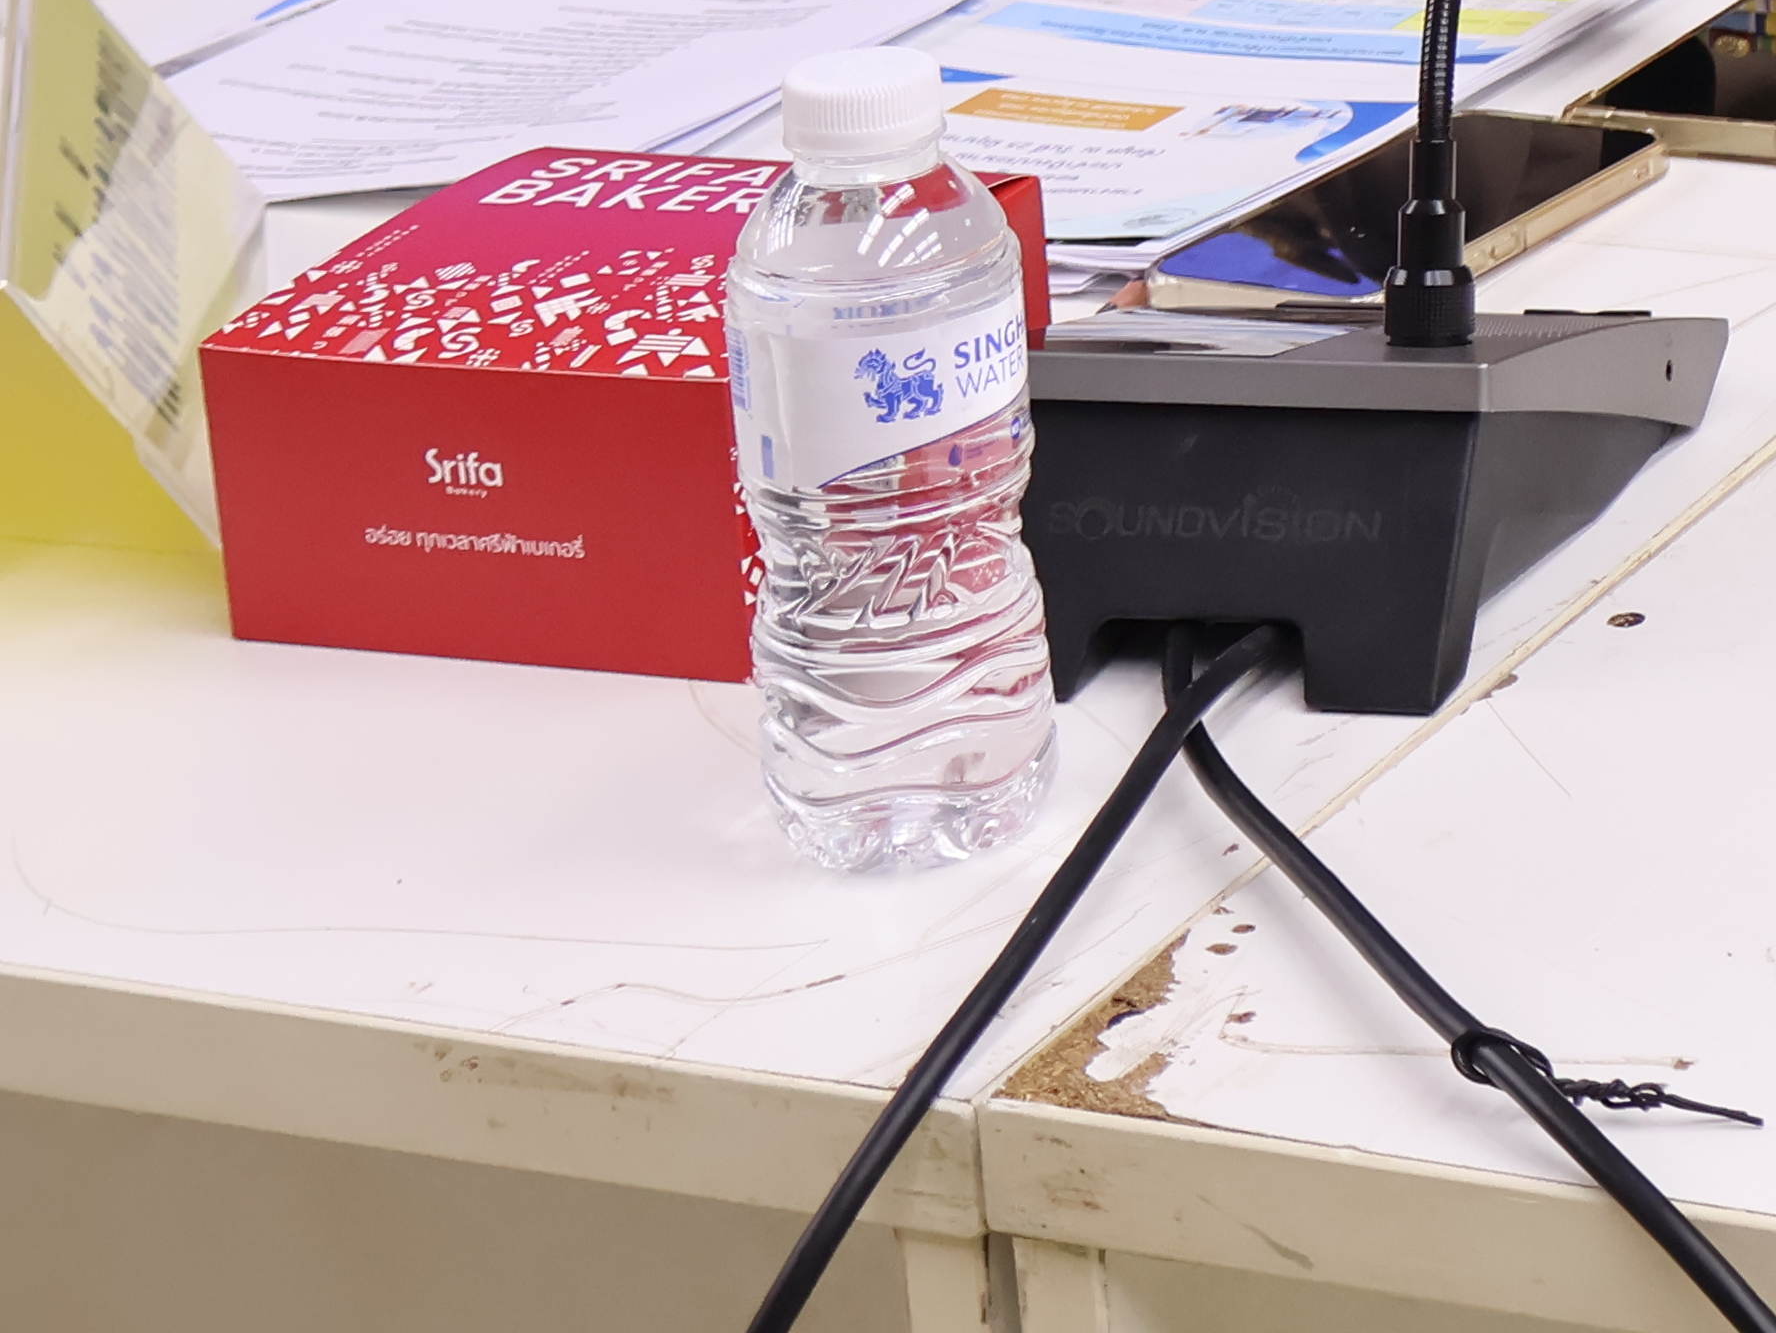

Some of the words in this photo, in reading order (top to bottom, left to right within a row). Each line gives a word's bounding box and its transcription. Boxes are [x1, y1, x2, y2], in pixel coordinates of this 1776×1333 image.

[532, 157, 778, 187] SRIFA
[479, 178, 766, 215] BAKER
[954, 313, 1026, 370] SINGH
[955, 345, 1024, 399] WATER
[426, 447, 505, 488] Srifa
[445, 485, 488, 498] Bakery
[365, 524, 412, 547] อร่อย
